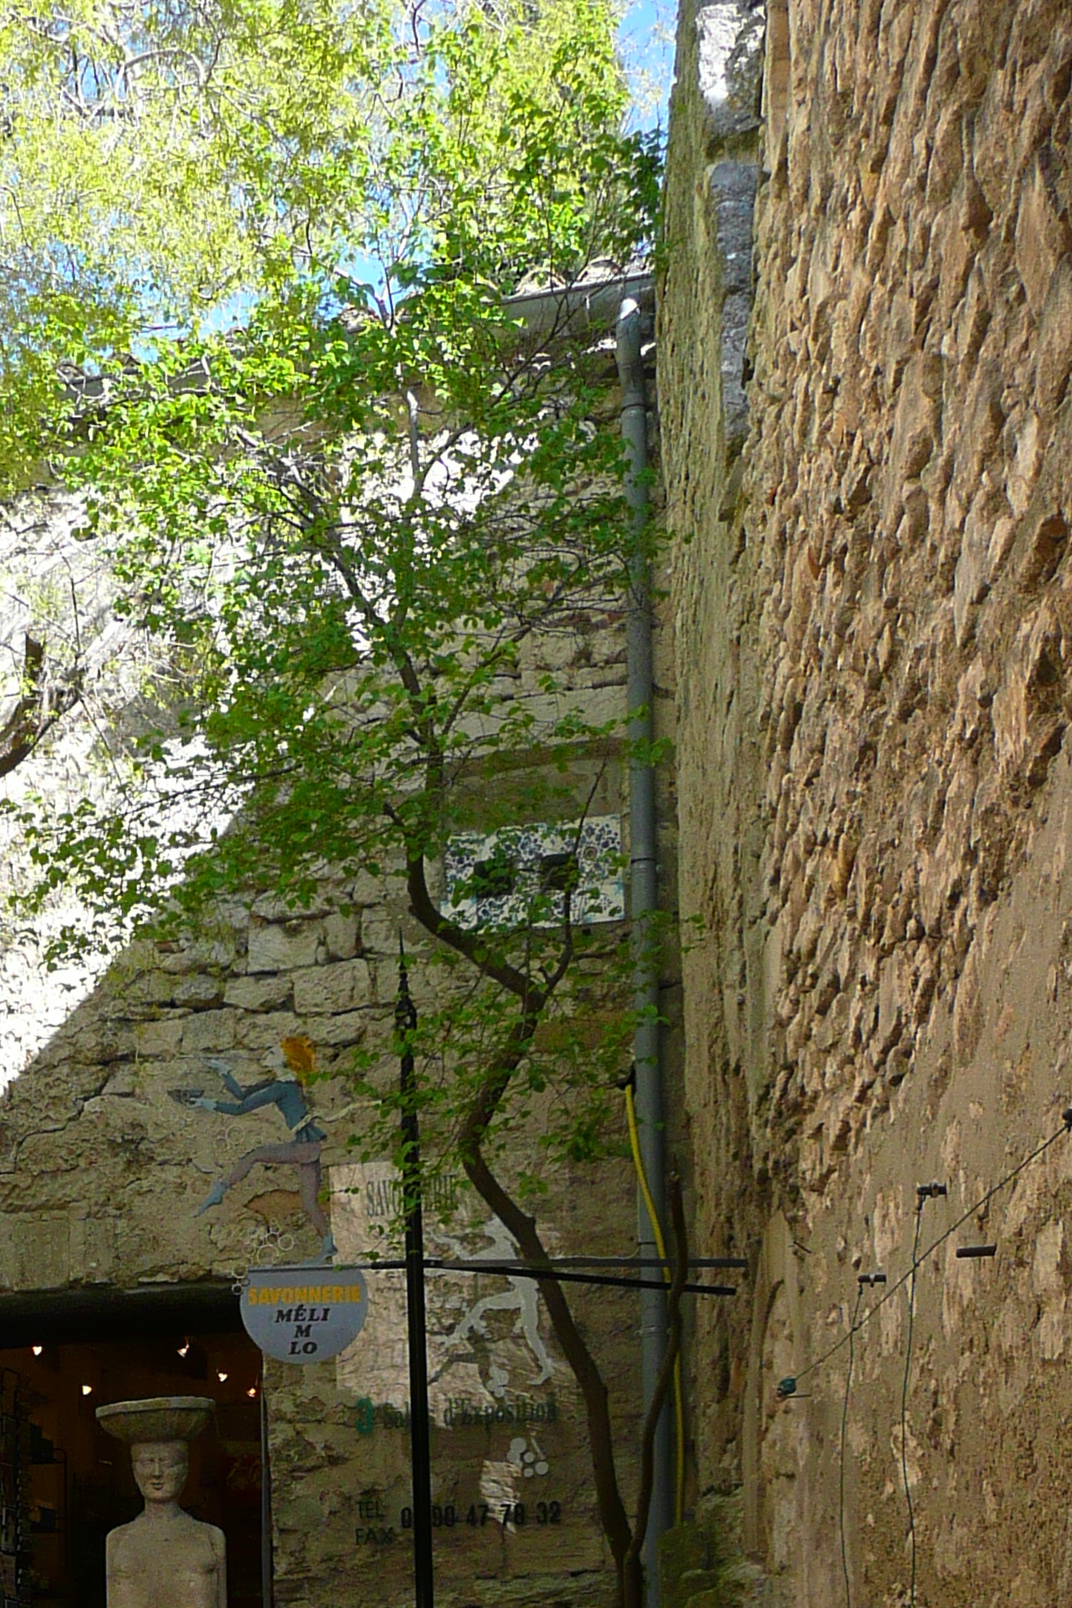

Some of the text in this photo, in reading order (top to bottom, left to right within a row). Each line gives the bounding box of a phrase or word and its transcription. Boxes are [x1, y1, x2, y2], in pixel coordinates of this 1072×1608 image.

[248, 1285, 361, 1305] SAVONNERIE
[274, 1304, 330, 1323] MÉLI
[294, 1324, 312, 1339] M
[288, 1341, 318, 1355] LO
[466, 1504, 489, 1527] 47
[536, 1500, 562, 1524] 32
[354, 1527, 395, 1546] FAX
